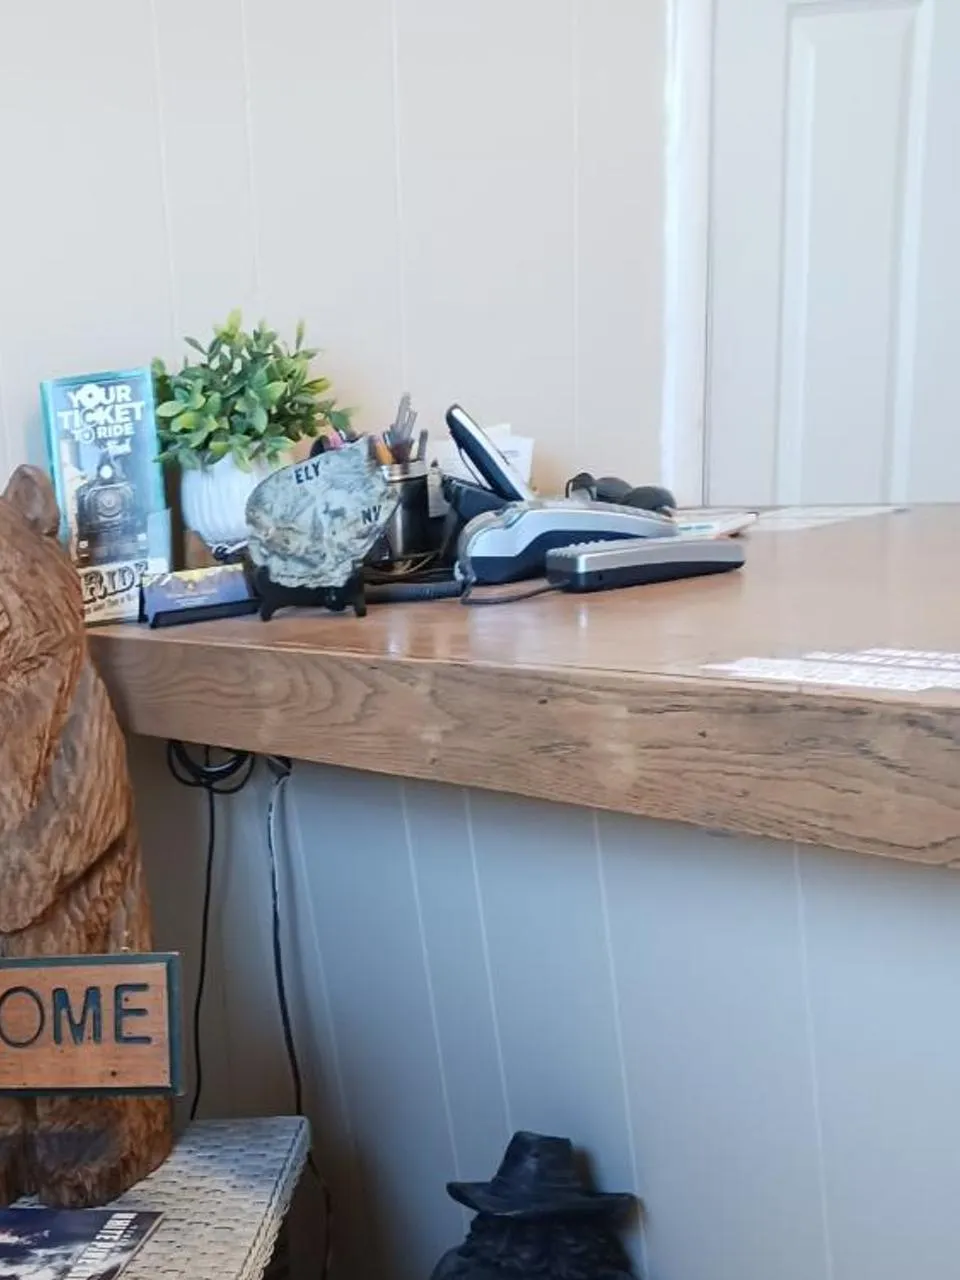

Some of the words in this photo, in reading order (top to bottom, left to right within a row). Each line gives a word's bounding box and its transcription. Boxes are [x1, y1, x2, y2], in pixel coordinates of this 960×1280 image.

[67, 383, 132, 409] YOUR
[57, 401, 145, 429] TICKET
[70, 427, 96, 443] TO
[96, 422, 135, 439] RIDE
[294, 461, 320, 485] ELY
[361, 505, 382, 525] NV
